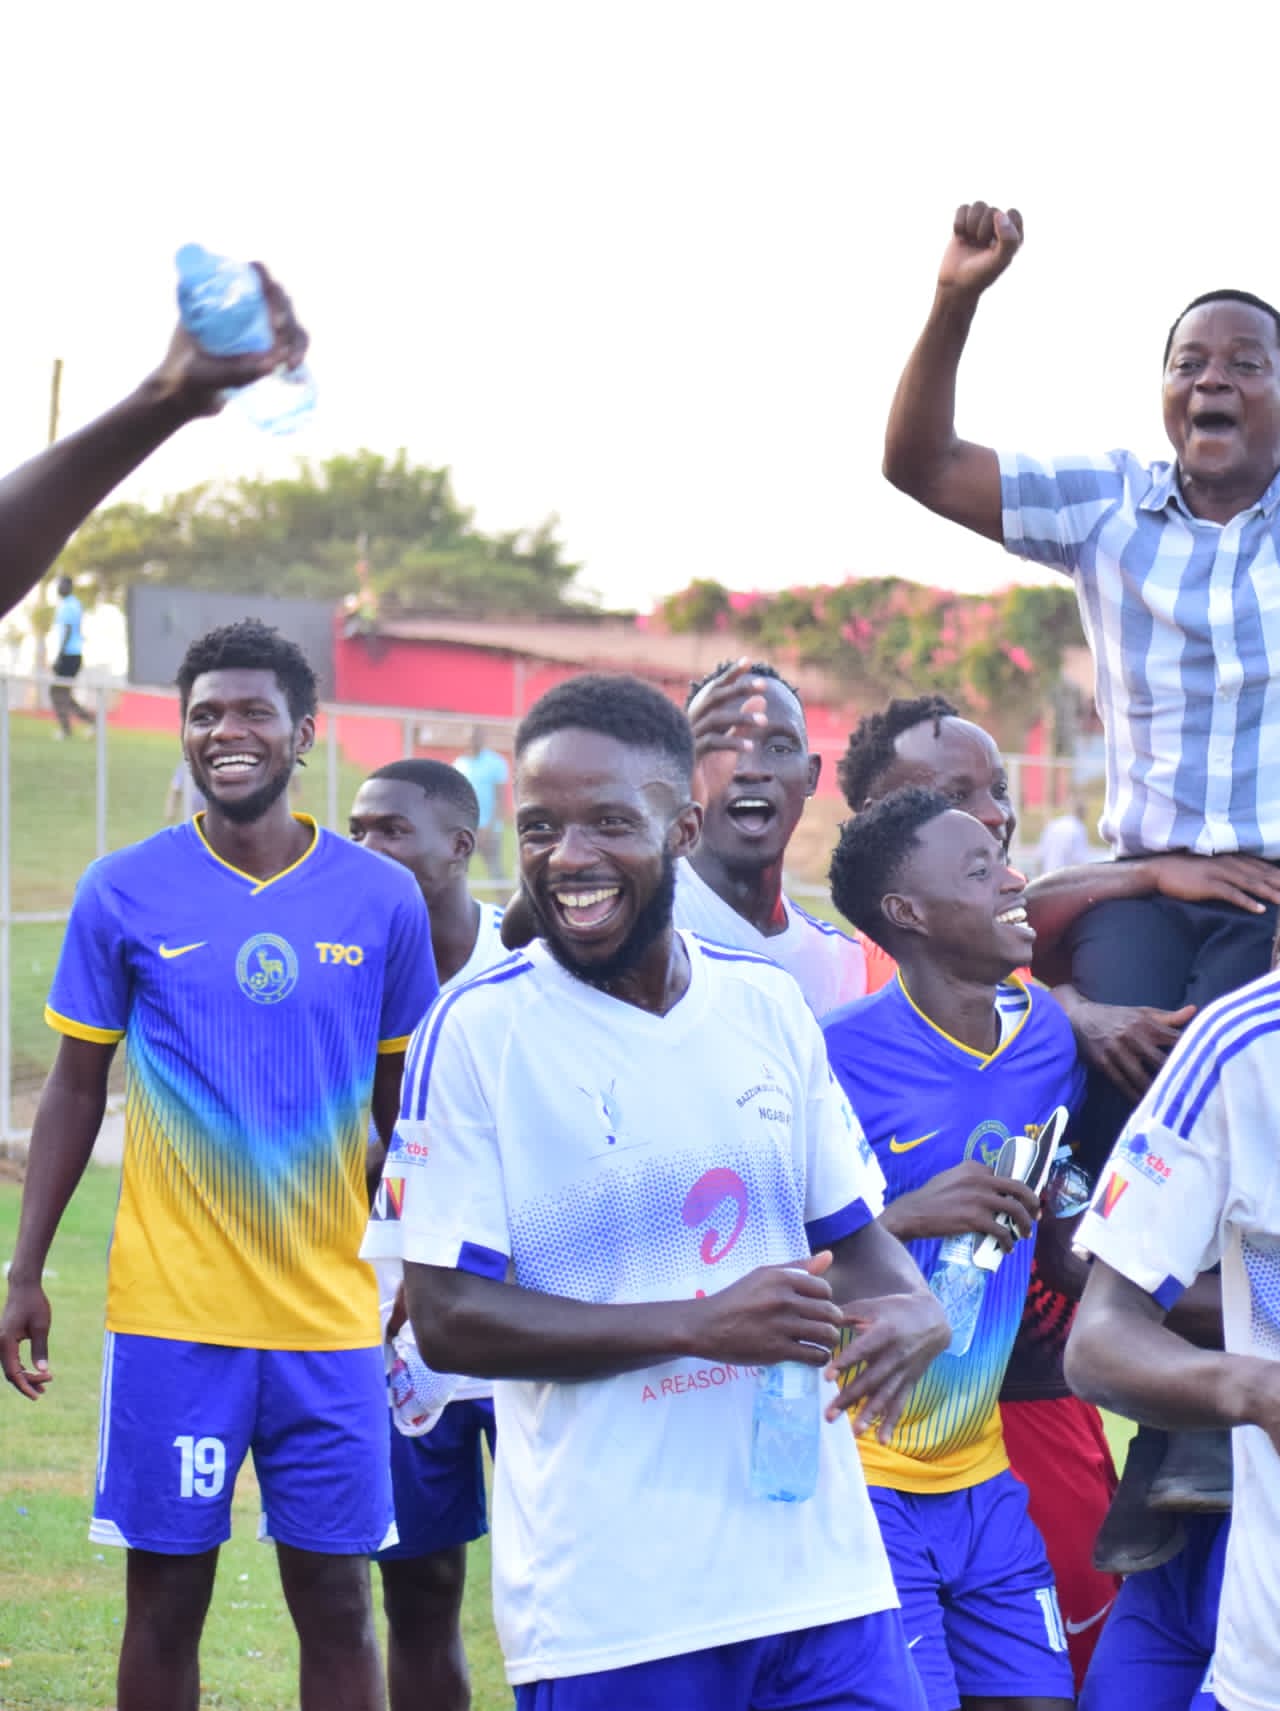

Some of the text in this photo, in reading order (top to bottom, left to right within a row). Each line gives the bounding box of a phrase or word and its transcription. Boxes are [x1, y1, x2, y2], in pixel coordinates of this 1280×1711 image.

[315, 942, 363, 966] T90
[406, 1142, 428, 1156] cbs
[641, 1385, 657, 1403] A
[660, 1364, 738, 1396] REASON
[173, 1435, 226, 1498] 19
